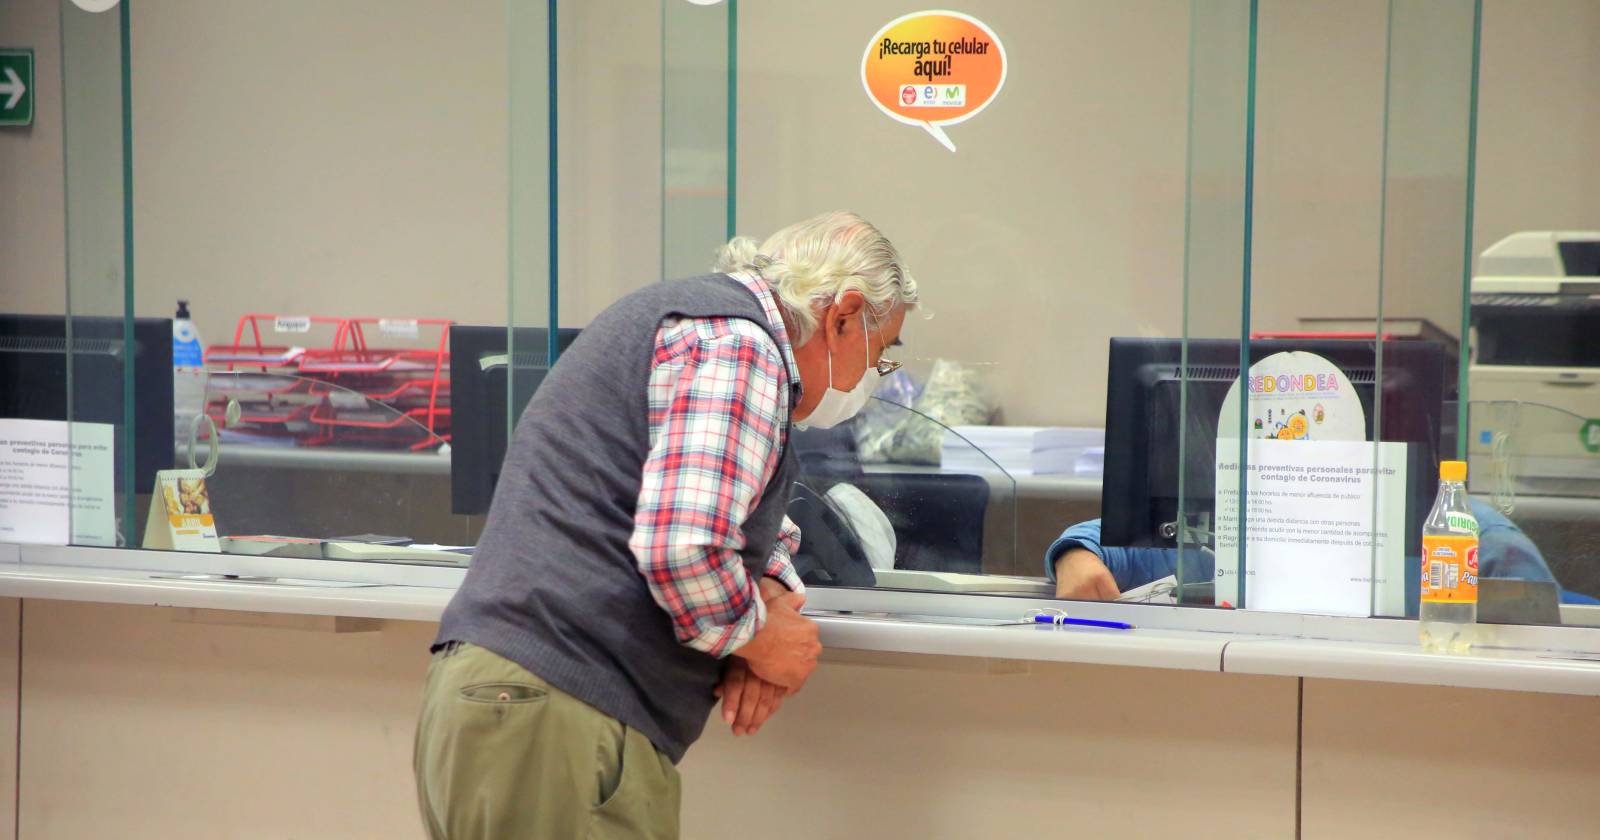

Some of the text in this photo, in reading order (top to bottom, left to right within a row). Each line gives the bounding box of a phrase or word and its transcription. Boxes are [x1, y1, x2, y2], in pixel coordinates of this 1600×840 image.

[880, 37, 989, 59] ¡Recarga tu celular
[914, 55, 952, 81] aquí!
[1248, 373, 1339, 393] REDONDEA
[1218, 462, 1257, 472] Medias
[1258, 464, 1304, 473] preventivas
[1306, 466, 1354, 475] personales
[1376, 468, 1396, 476] vitar
[1261, 473, 1361, 484] contagio de Coronavirus
